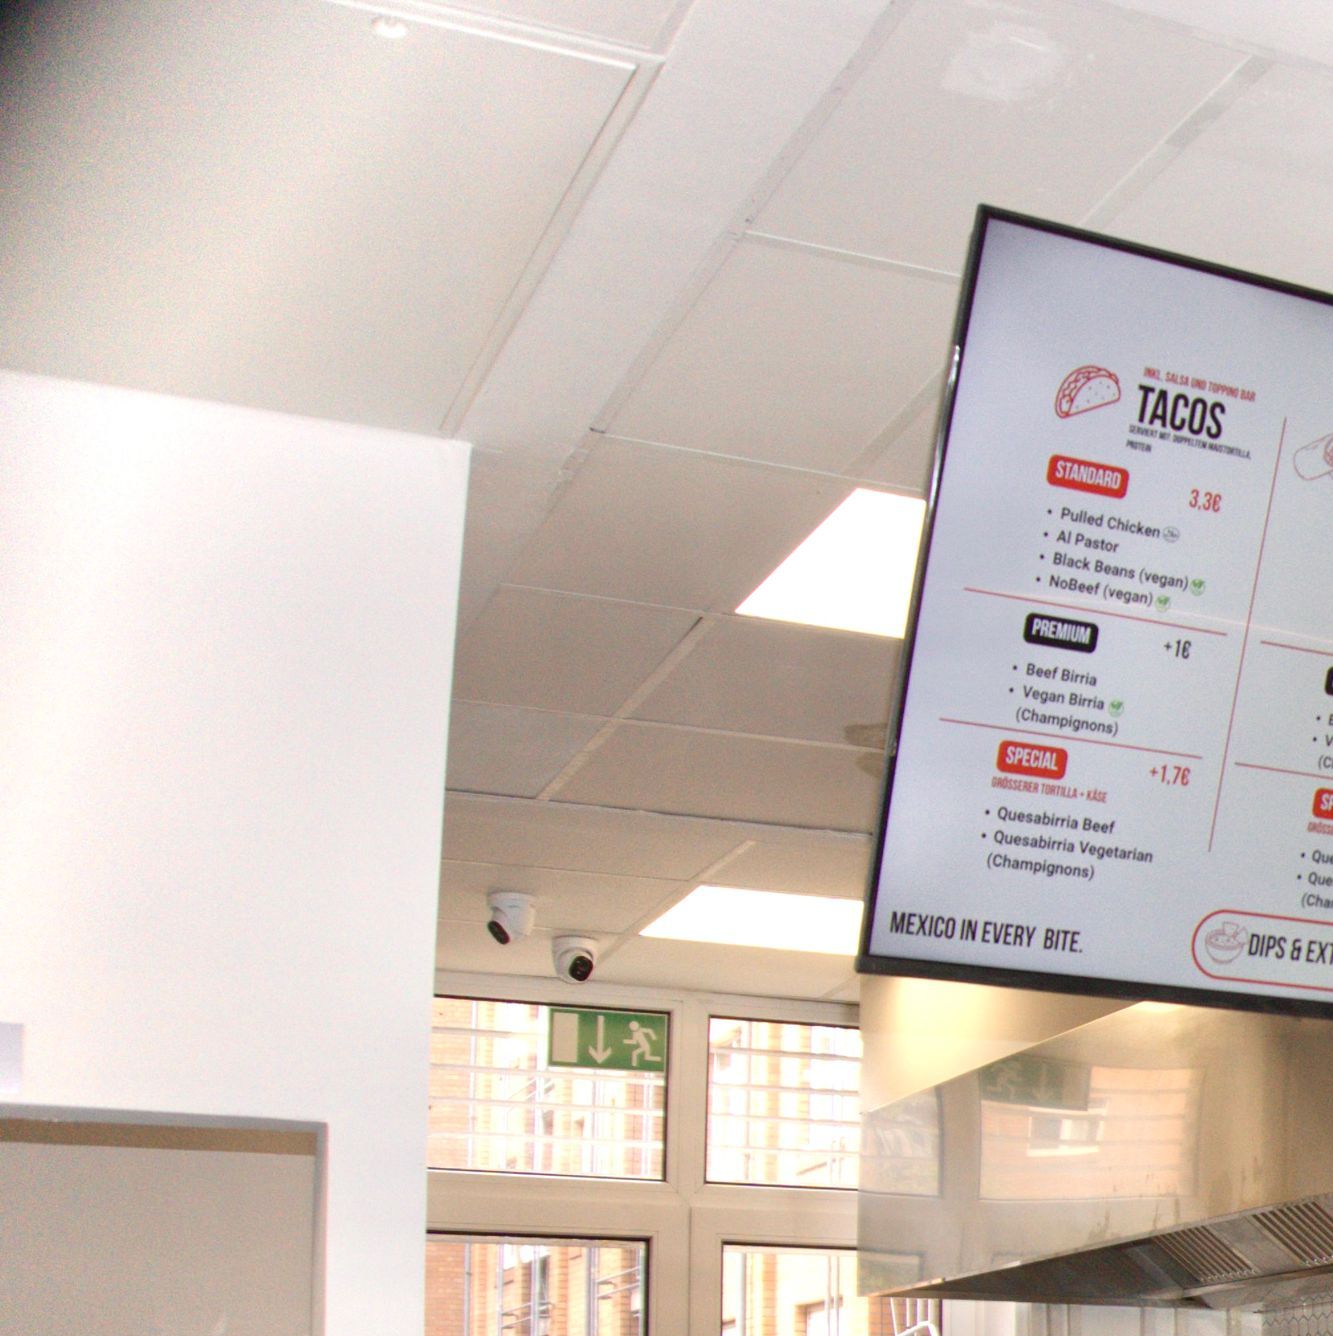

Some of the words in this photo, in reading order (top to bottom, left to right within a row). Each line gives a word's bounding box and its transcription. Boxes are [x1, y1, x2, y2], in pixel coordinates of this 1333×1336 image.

[1164, 371, 1190, 387] SALSA
[1190, 377, 1207, 391] UND
[1208, 380, 1239, 399] TOPPING
[1239, 389, 1256, 402] BAR
[1137, 383, 1226, 440] TACOS
[1055, 460, 1122, 489] STANDARD
[1188, 488, 1222, 513] 3,3€
[1060, 506, 1104, 528] Pulled
[1106, 516, 1161, 538] Chicken
[1056, 529, 1072, 544] Al
[1074, 532, 1119, 553] Pastor
[1052, 551, 1090, 571] Black
[1093, 559, 1136, 580] Beans
[1138, 567, 1189, 592] (vegan)
[1048, 574, 1101, 595] NoBeef
[1102, 583, 1154, 607] (vegan)
[1031, 617, 1092, 644] PREMIUM
[1163, 638, 1192, 660] +1€
[1025, 662, 1058, 679] Beef
[1060, 667, 1097, 687] Birria
[1022, 684, 1065, 705] Vegan
[1068, 691, 1105, 711] Birria
[1015, 706, 1119, 737] (Champignons)
[1005, 745, 1058, 771] SPECIAL
[990, 775, 1040, 794] GRÖSSERER
[1040, 782, 1078, 799] TORTILLA
[1085, 788, 1108, 804] KÄSE
[1149, 764, 1191, 787] +1,7€
[996, 805, 1079, 830] Quesabirria
[1081, 817, 1115, 834] Beef
[993, 829, 1075, 853] Quesabirria
[1079, 840, 1154, 863] Vegetarian
[986, 852, 1095, 881] (Champignons)
[889, 910, 956, 939] MEXICO
[959, 918, 978, 942] IN
[980, 920, 1037, 948] EVERY
[1042, 927, 1082, 953] BITE.
[1247, 932, 1287, 959] DIPS
[1289, 938, 1302, 961] &
